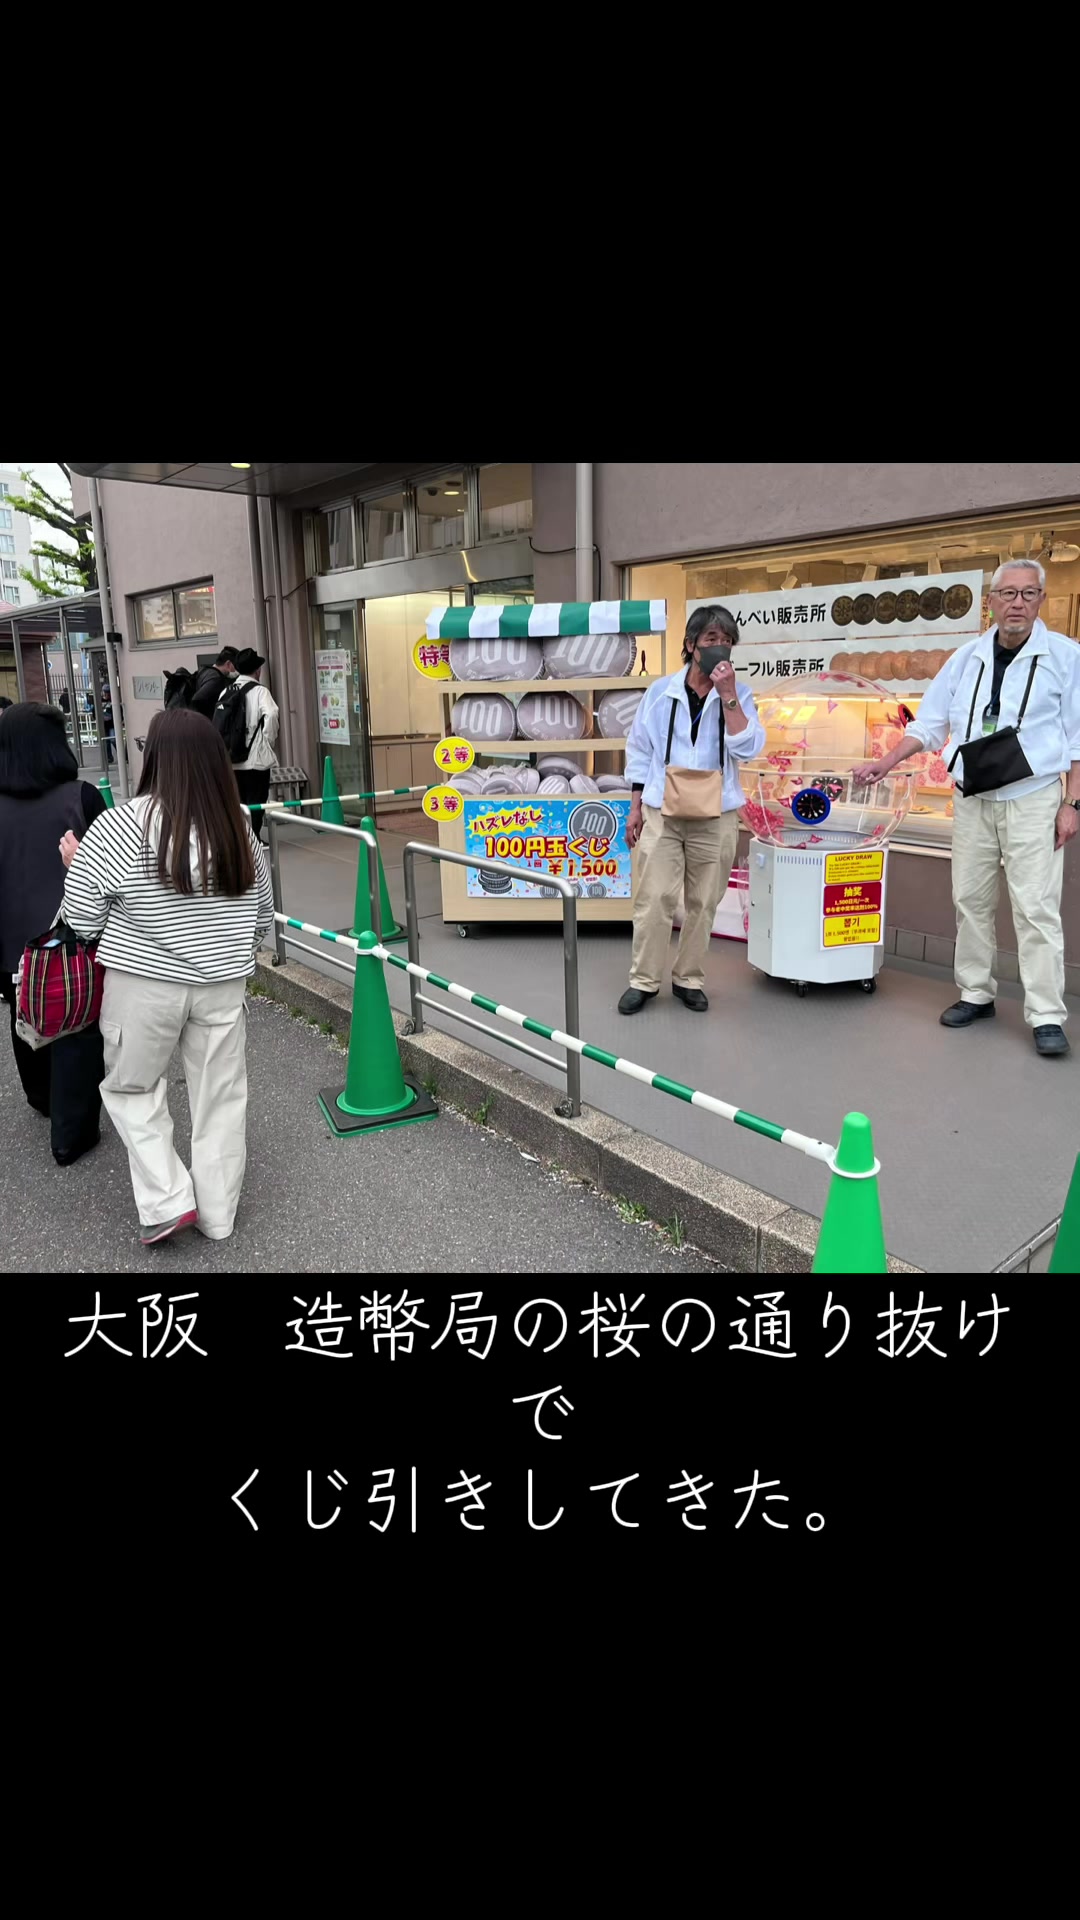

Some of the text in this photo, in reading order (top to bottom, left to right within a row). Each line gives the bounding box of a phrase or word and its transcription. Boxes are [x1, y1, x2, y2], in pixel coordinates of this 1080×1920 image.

[458, 698, 503, 737] 100
[530, 694, 579, 729] 100
[440, 747, 470, 764] 2等
[430, 795, 459, 812] 3等
[473, 810, 544, 833] ハズレなし
[580, 811, 608, 836] 100
[485, 836, 610, 859] 100円玉くじ
